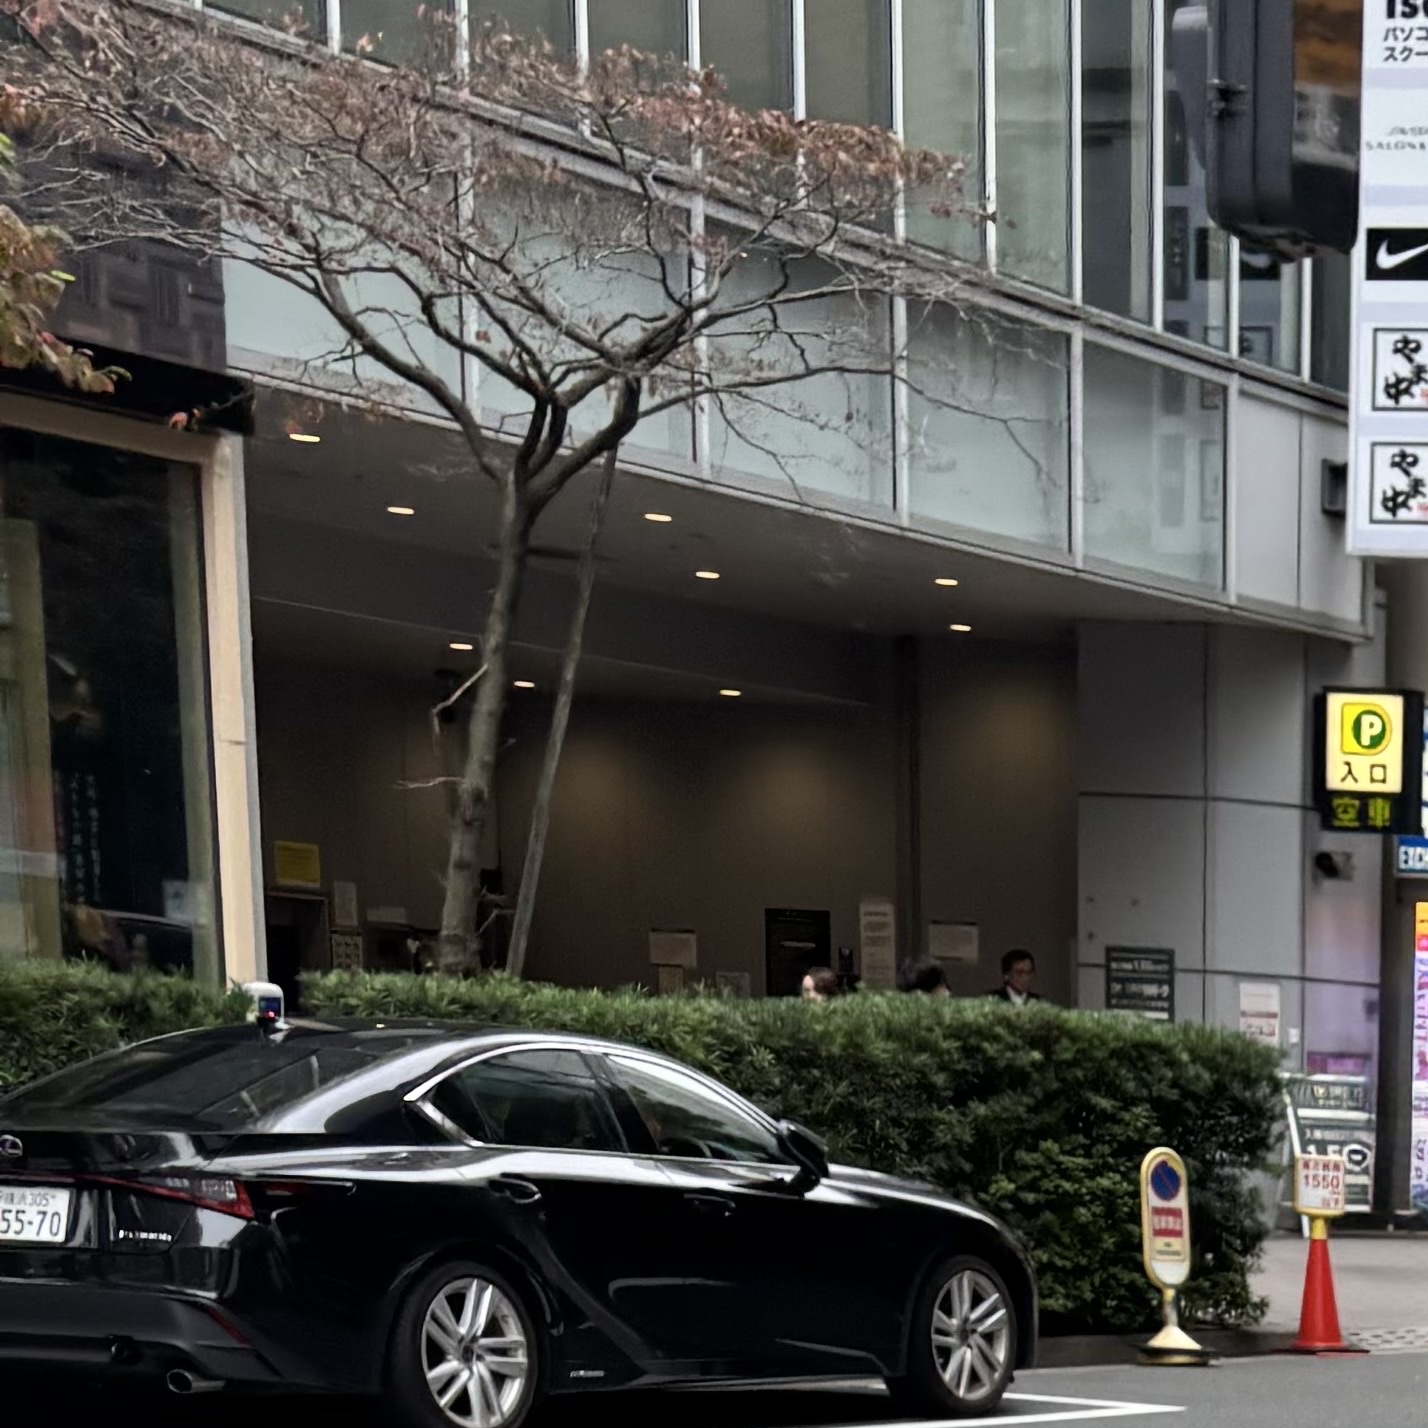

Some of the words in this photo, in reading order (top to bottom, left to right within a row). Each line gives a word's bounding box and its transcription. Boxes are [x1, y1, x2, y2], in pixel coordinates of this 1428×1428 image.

[1361, 714, 1383, 746] P
[1340, 761, 1387, 784] 入口
[1303, 1174, 1341, 1189] 1550
[0, 1209, 61, 1237] 55-70
